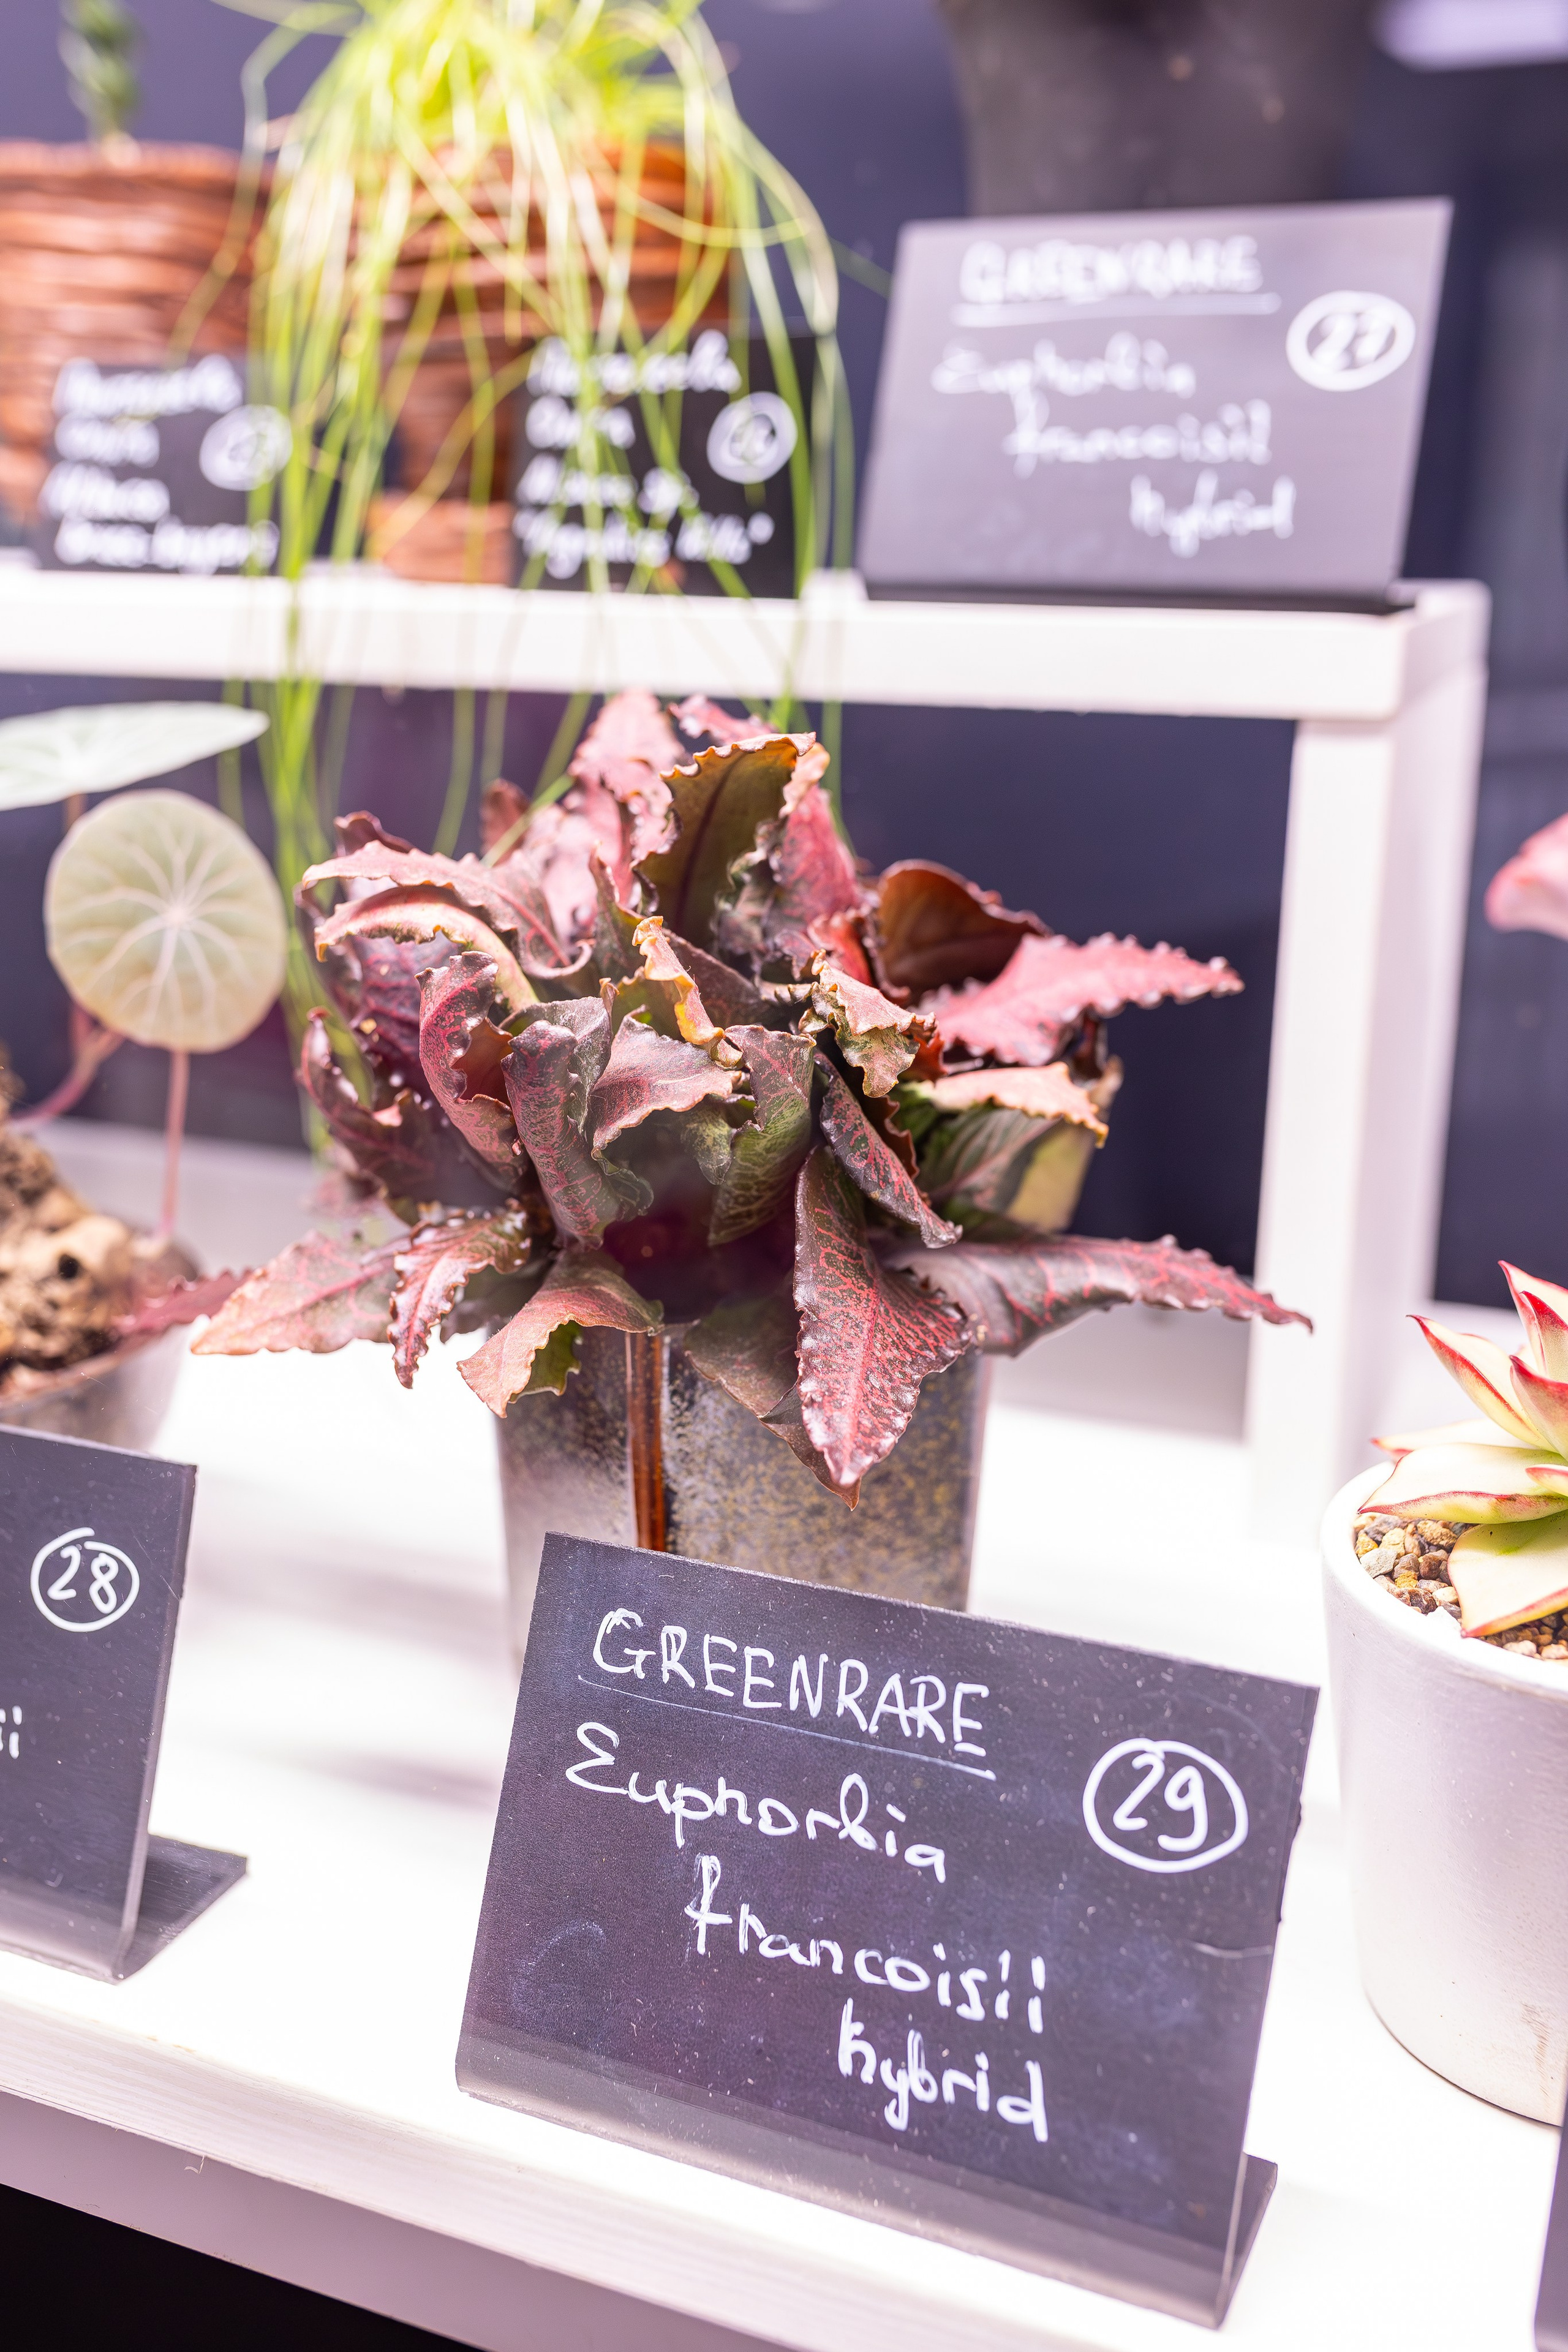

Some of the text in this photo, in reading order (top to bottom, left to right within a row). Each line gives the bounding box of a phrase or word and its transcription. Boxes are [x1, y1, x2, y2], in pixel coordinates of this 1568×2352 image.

[47, 1545, 118, 1615] 28
[592, 1607, 990, 1755] GREENRARE
[565, 1722, 946, 1883] Euphorbia
[1112, 1752, 1208, 1852] 29
[684, 1854, 1046, 2034] francoisii
[837, 1997, 1049, 2143] hybrid
